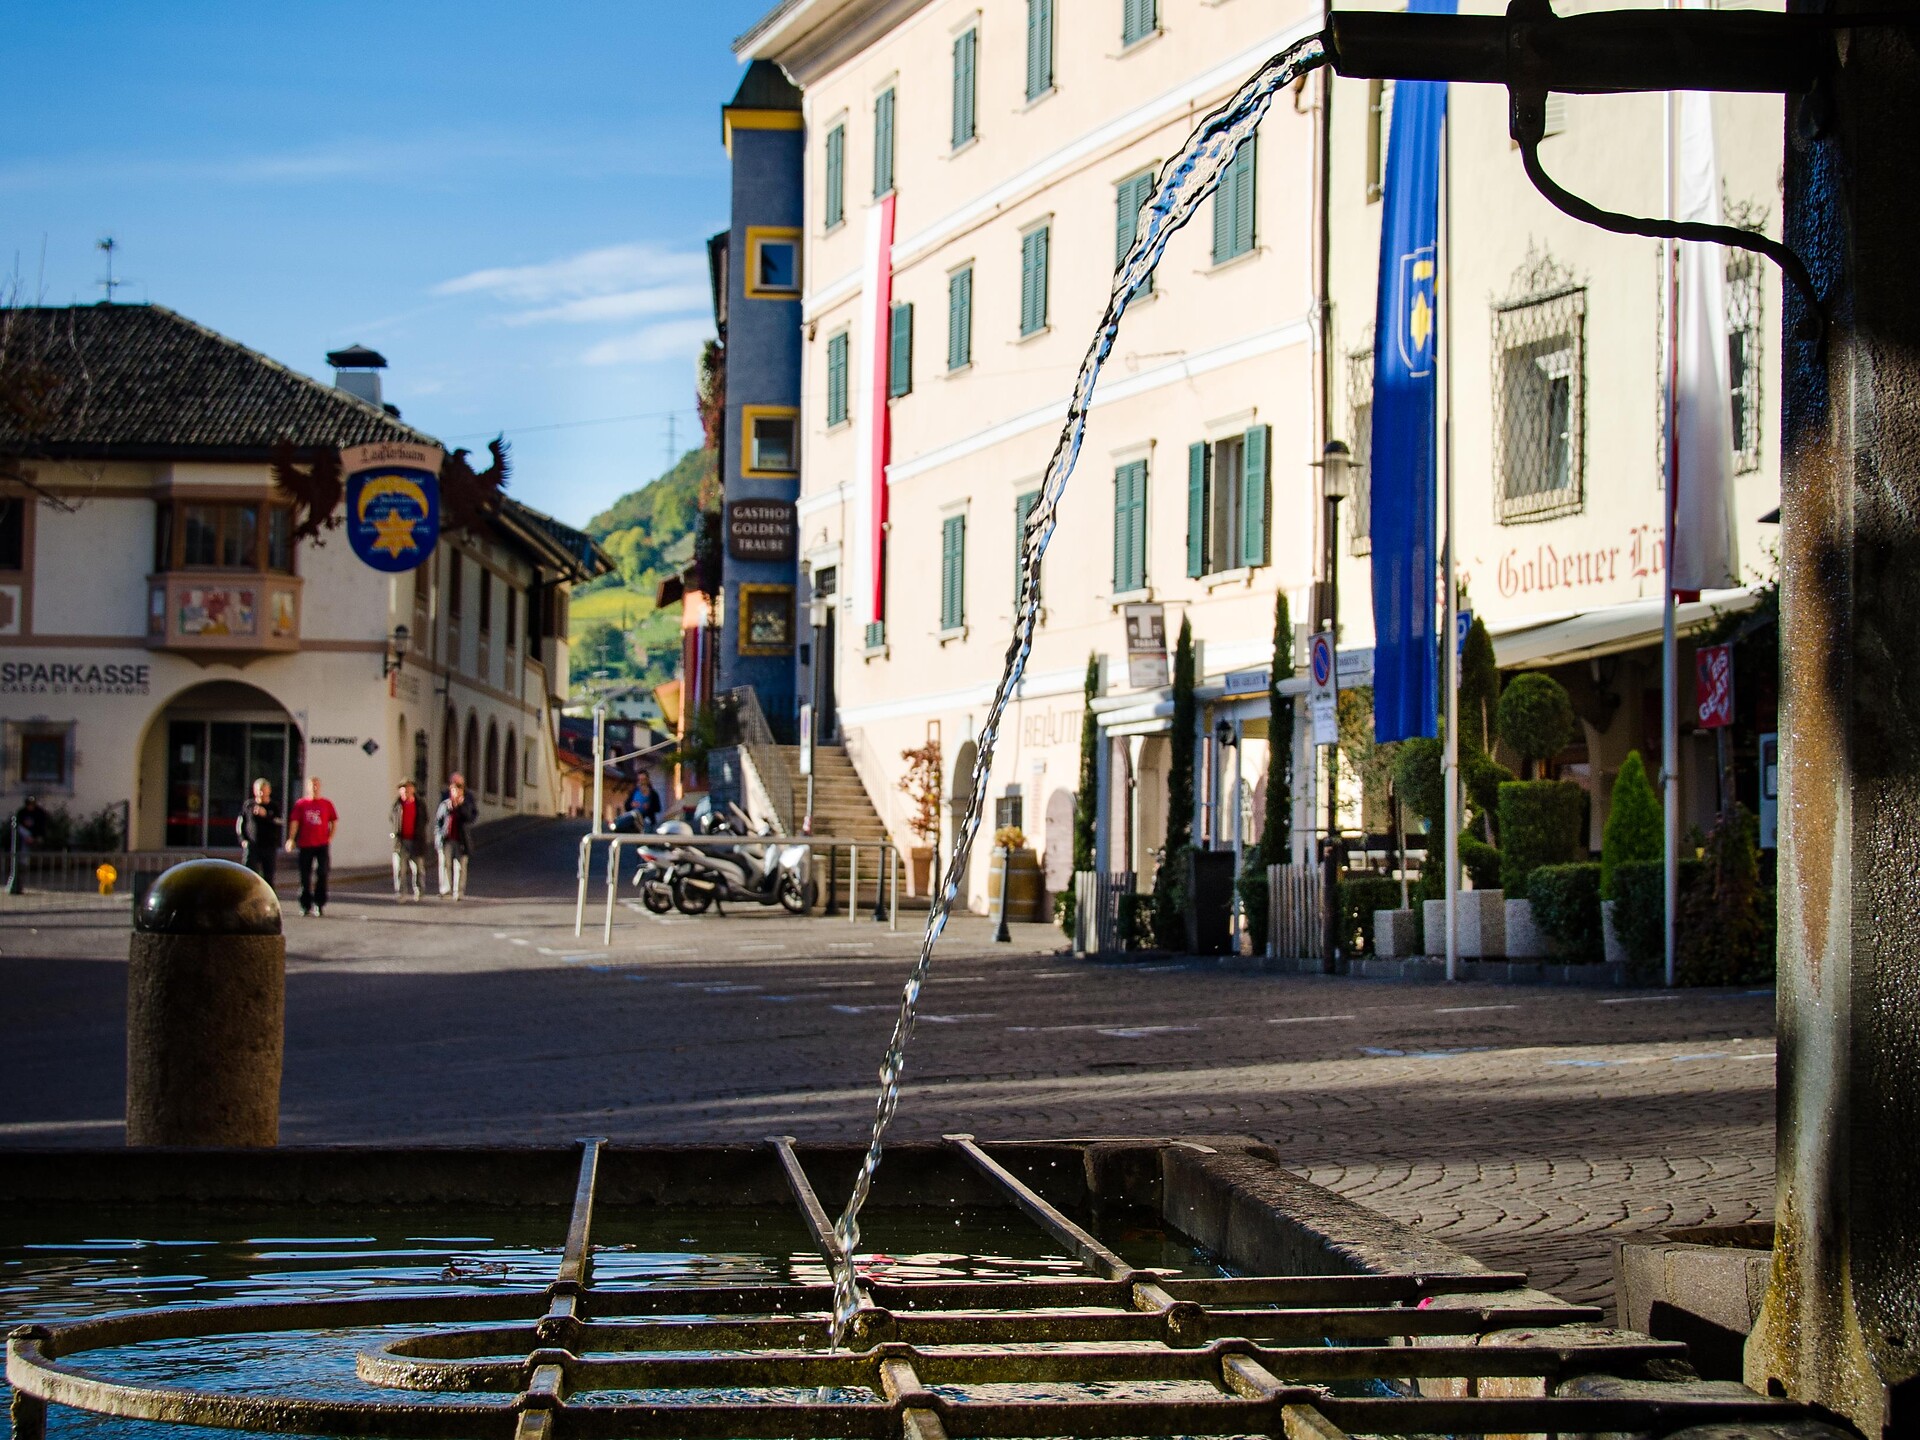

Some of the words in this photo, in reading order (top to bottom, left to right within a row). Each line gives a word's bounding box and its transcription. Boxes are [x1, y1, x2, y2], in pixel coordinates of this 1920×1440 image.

[732, 506, 790, 519] GASTHOF
[731, 522, 790, 535] GOLDENE
[738, 538, 783, 551] TRAUBE
[1498, 545, 1620, 598] Goldener
[2, 662, 149, 684] SPARKASSE
[2, 684, 48, 694] CASSA
[55, 685, 68, 694] DI
